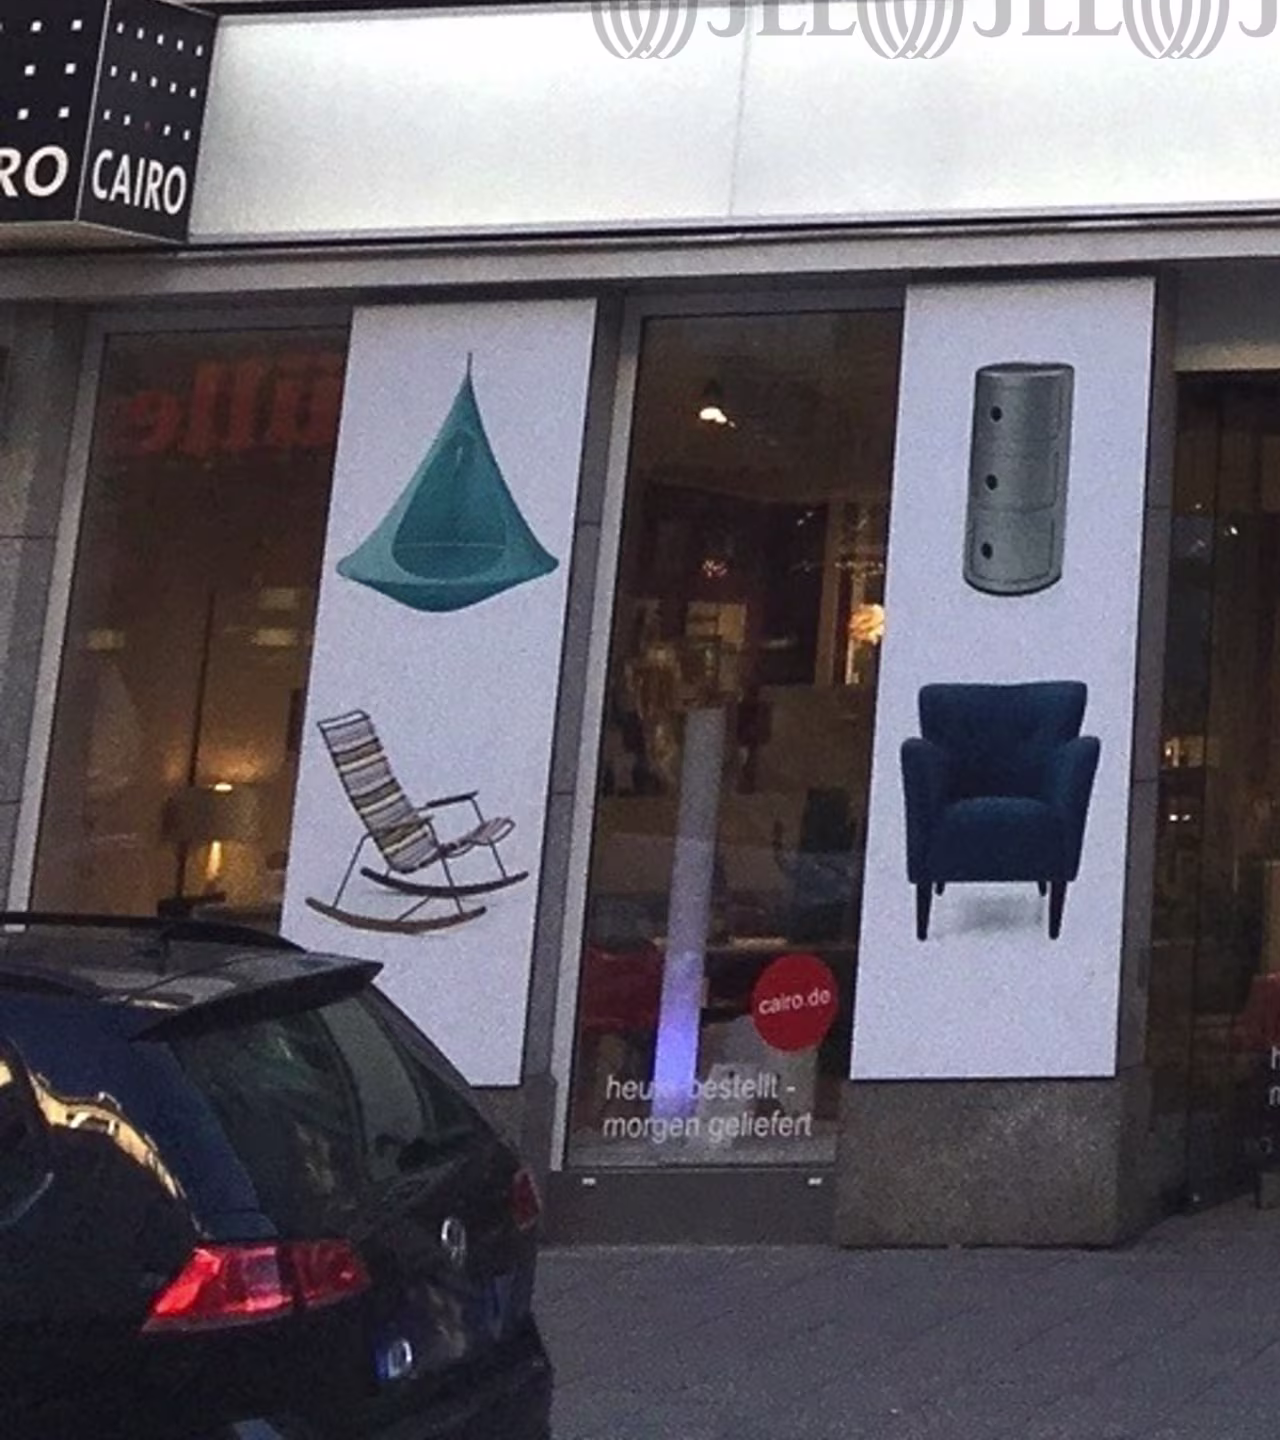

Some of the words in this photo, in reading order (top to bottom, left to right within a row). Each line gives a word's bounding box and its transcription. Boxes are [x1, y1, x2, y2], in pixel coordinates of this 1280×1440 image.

[92, 149, 187, 215] CAIRO
[758, 988, 831, 1015] cairo.de
[603, 1115, 699, 1143] morgen
[708, 1110, 812, 1143] geliefert
